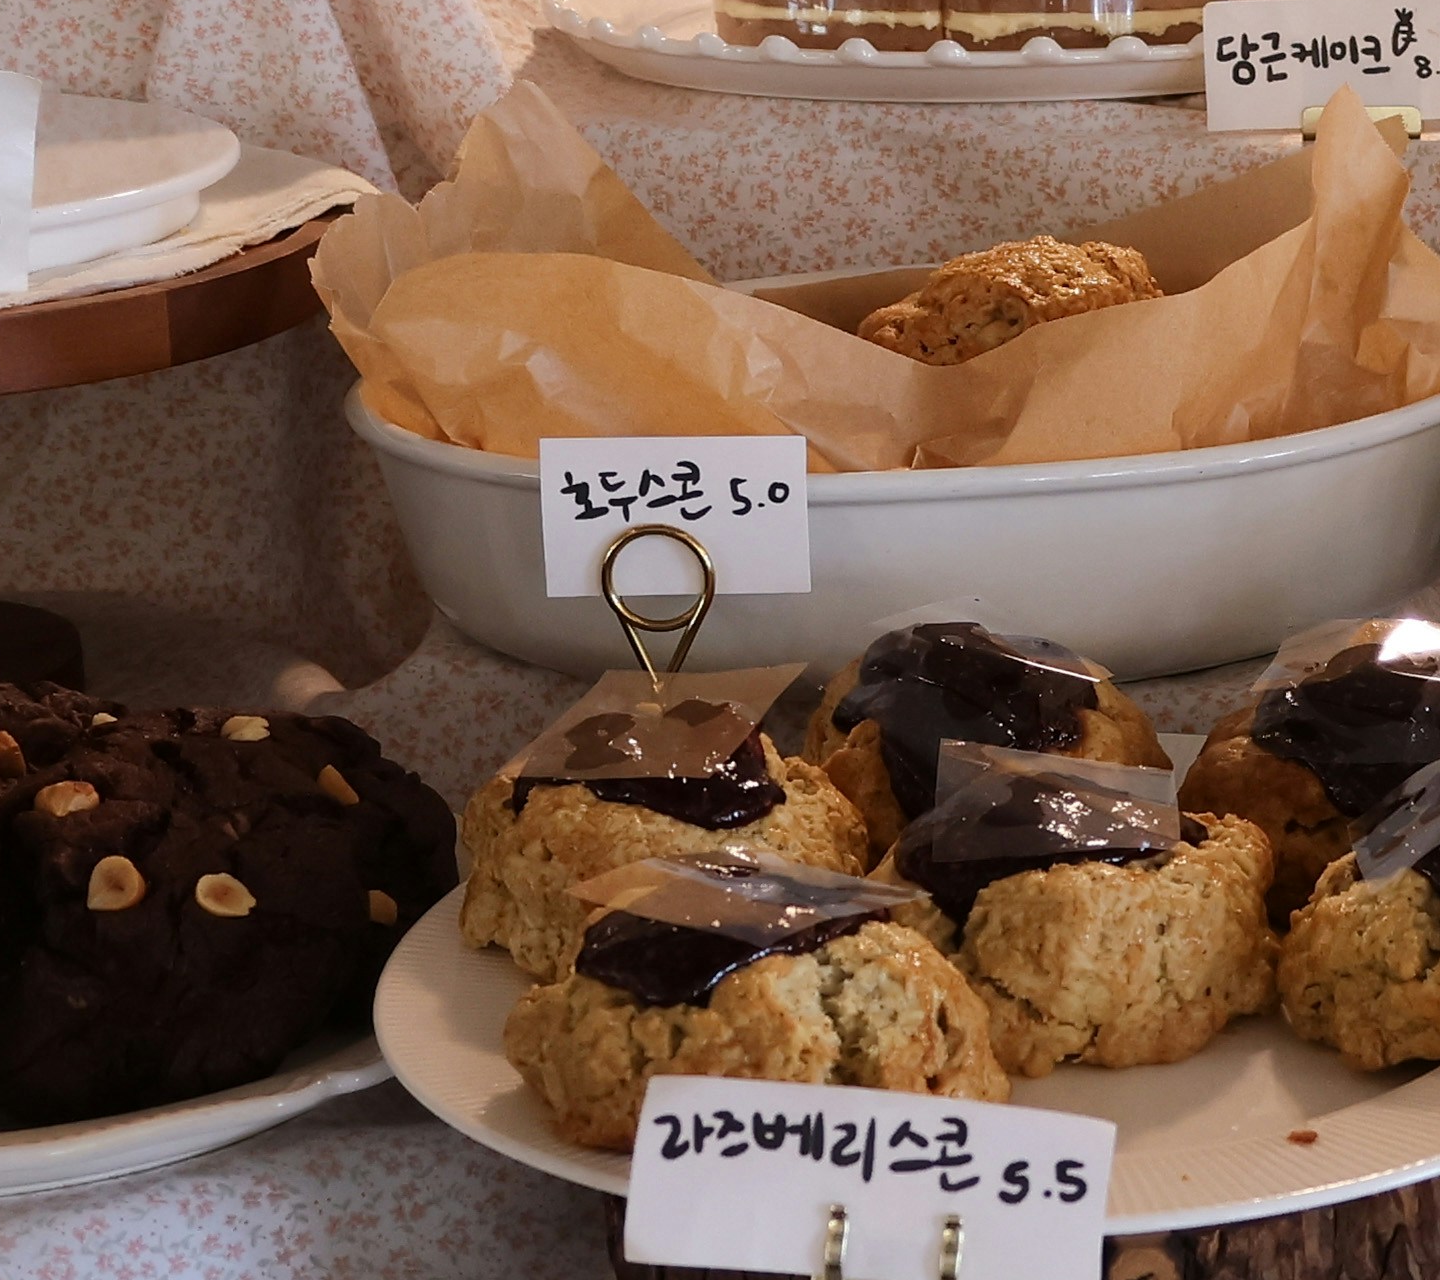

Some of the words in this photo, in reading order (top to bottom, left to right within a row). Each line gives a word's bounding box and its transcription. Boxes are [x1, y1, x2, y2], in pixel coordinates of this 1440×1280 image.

[1216, 32, 1391, 85] 당근케이크
[560, 460, 712, 522] 호두스콘
[730, 477, 790, 516] 5.0
[998, 1159, 1088, 1205] 5.5
